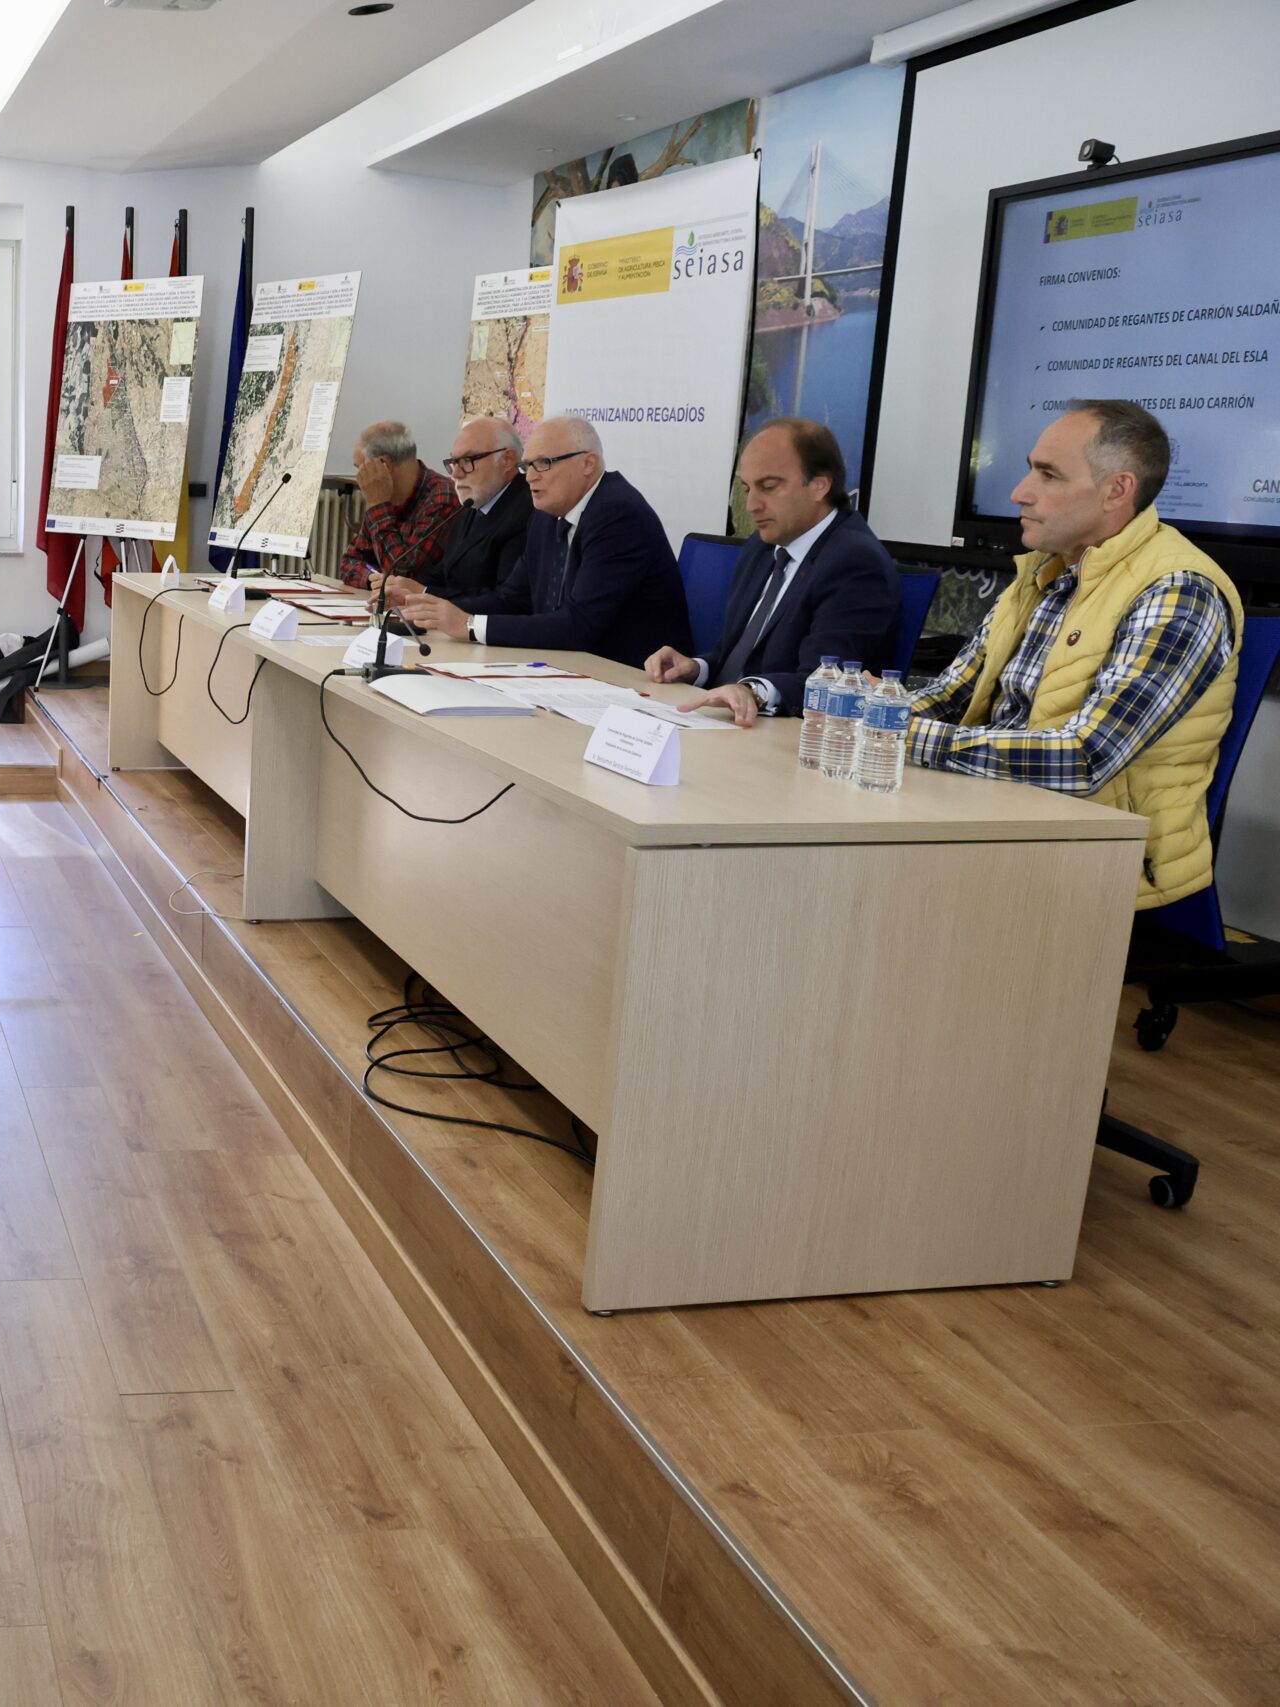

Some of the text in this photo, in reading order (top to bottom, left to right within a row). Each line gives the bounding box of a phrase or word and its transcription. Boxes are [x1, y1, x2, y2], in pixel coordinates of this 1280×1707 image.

[1137, 208, 1183, 228] seiasa
[672, 248, 745, 280] seiasa
[1039, 267, 1121, 287] FIRMA CONVENIOS:
[1052, 299, 1280, 332] COMUNIDAD DE REGANTES DE CARRIÓN SALDAÑ
[1047, 349, 1269, 372] COMUNIDAD DE REGANTES DEL CANAL DEL ESLA
[1159, 397, 1177, 410] DEL
[1179, 397, 1205, 410] BAJO
[1207, 393, 1255, 409] CARRIÓN
[646, 403, 705, 422] REGADÍOS
